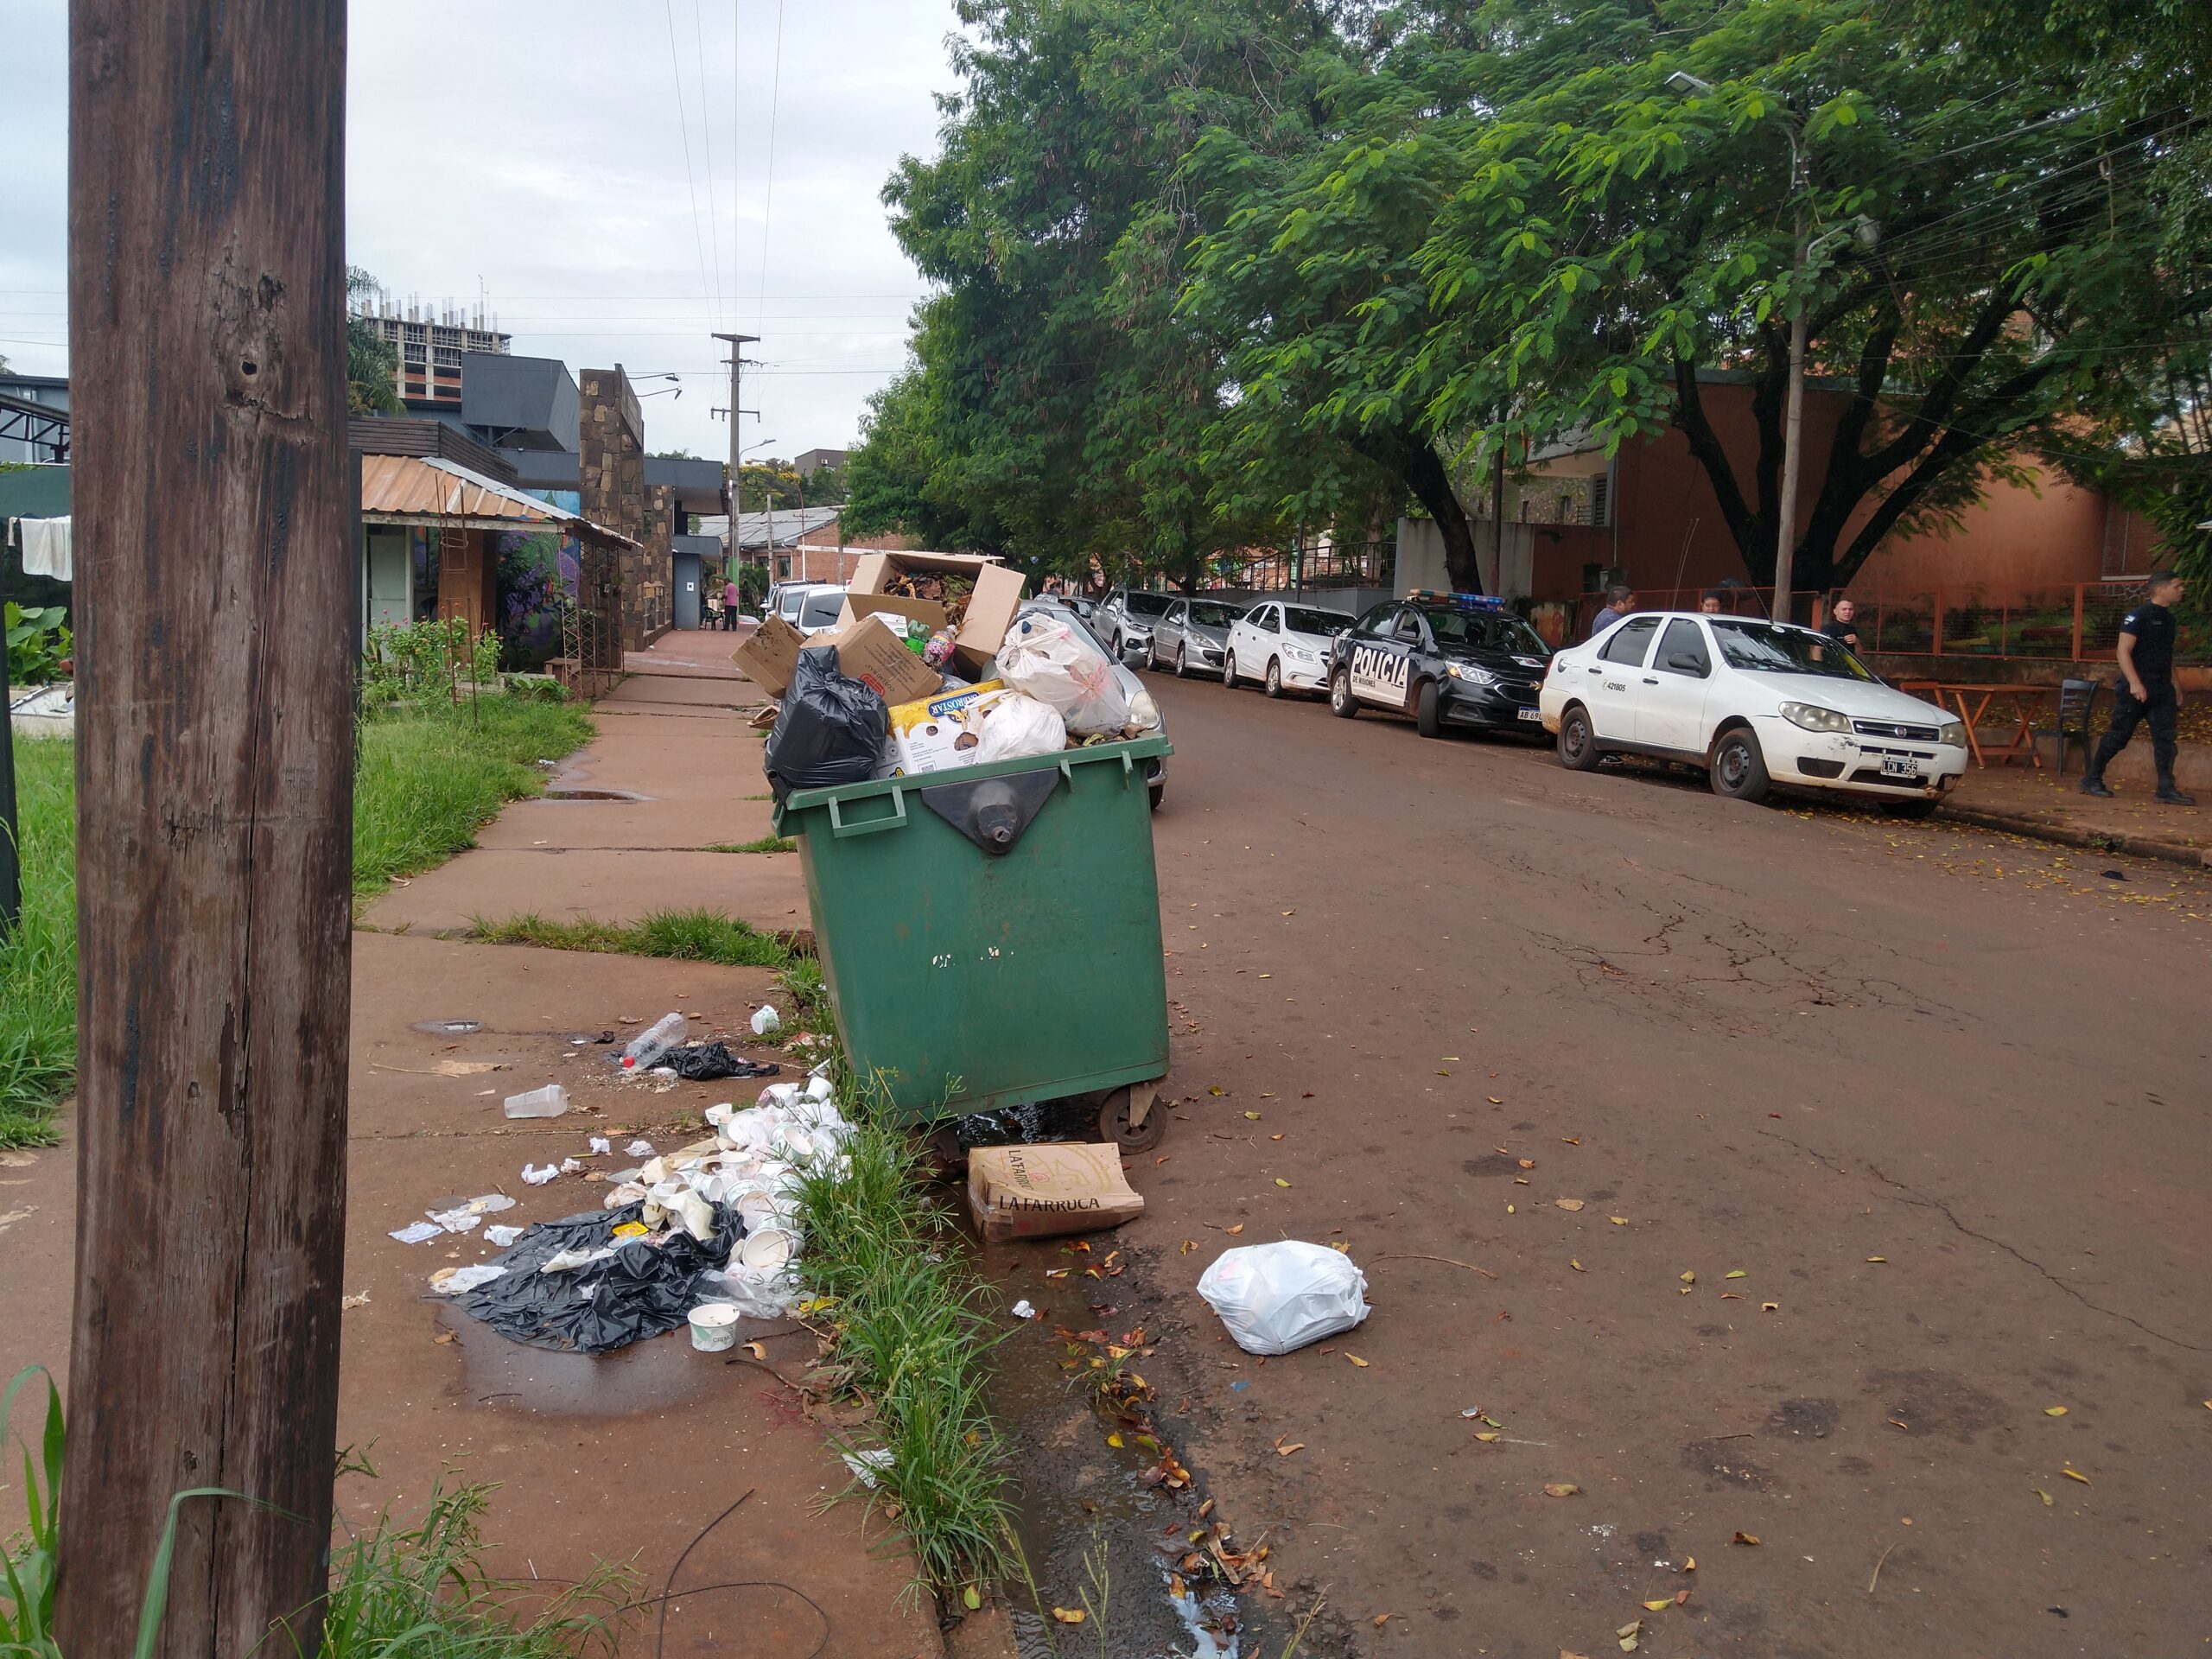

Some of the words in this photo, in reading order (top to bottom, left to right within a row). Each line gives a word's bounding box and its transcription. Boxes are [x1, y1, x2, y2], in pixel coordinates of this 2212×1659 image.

[1351, 646, 1409, 688] POLICIA
[1358, 677, 1376, 689] MISIONES
[1607, 682, 1626, 692] 421805
[1883, 760, 1897, 773] LCN
[1901, 763, 1916, 775] 356
[1000, 1195, 1020, 1211] LA
[1024, 1198, 1100, 1212] FARRUCA
